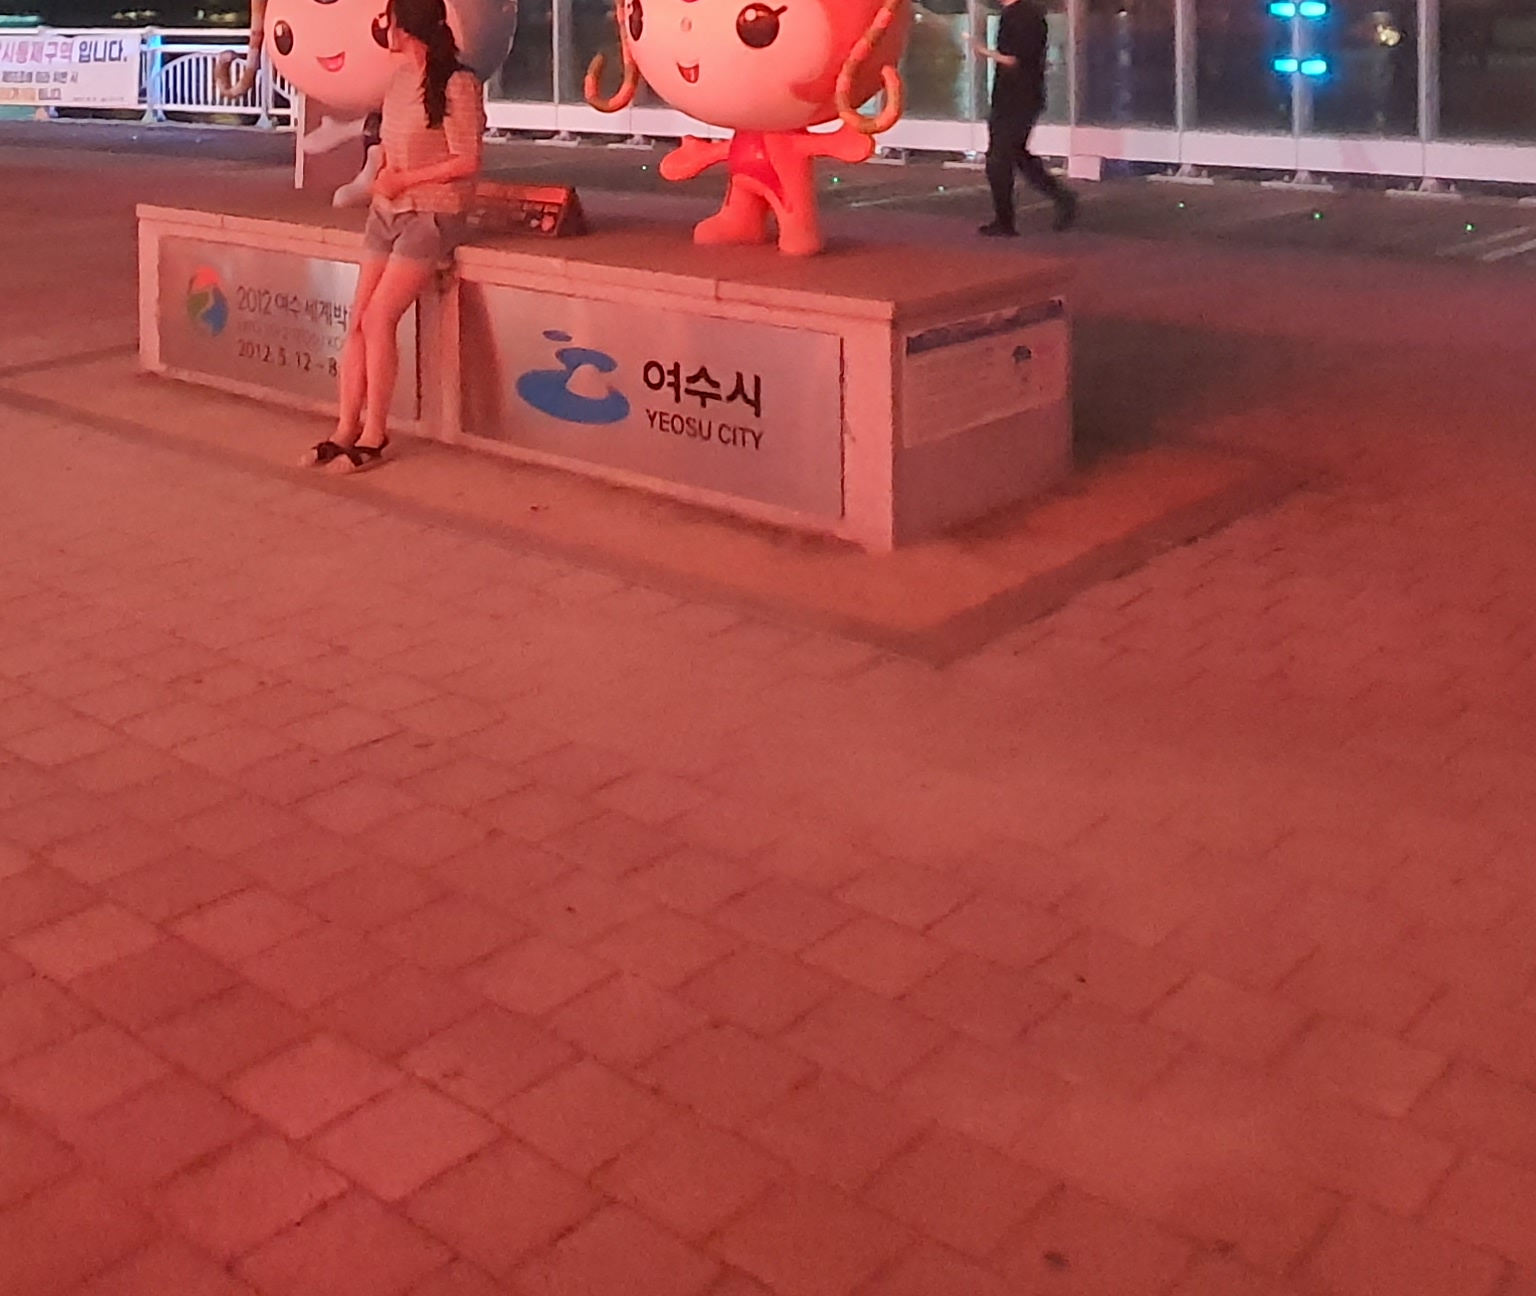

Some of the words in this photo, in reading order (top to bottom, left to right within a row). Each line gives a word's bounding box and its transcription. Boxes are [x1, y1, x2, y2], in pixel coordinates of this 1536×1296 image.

[78, 40, 128, 63] 입니다.
[236, 285, 272, 315] 2012
[274, 292, 301, 320] 여수
[304, 298, 348, 333] 세계박
[643, 360, 761, 418] 여수시
[646, 408, 712, 441] YEOSU
[718, 422, 763, 450] CITY
